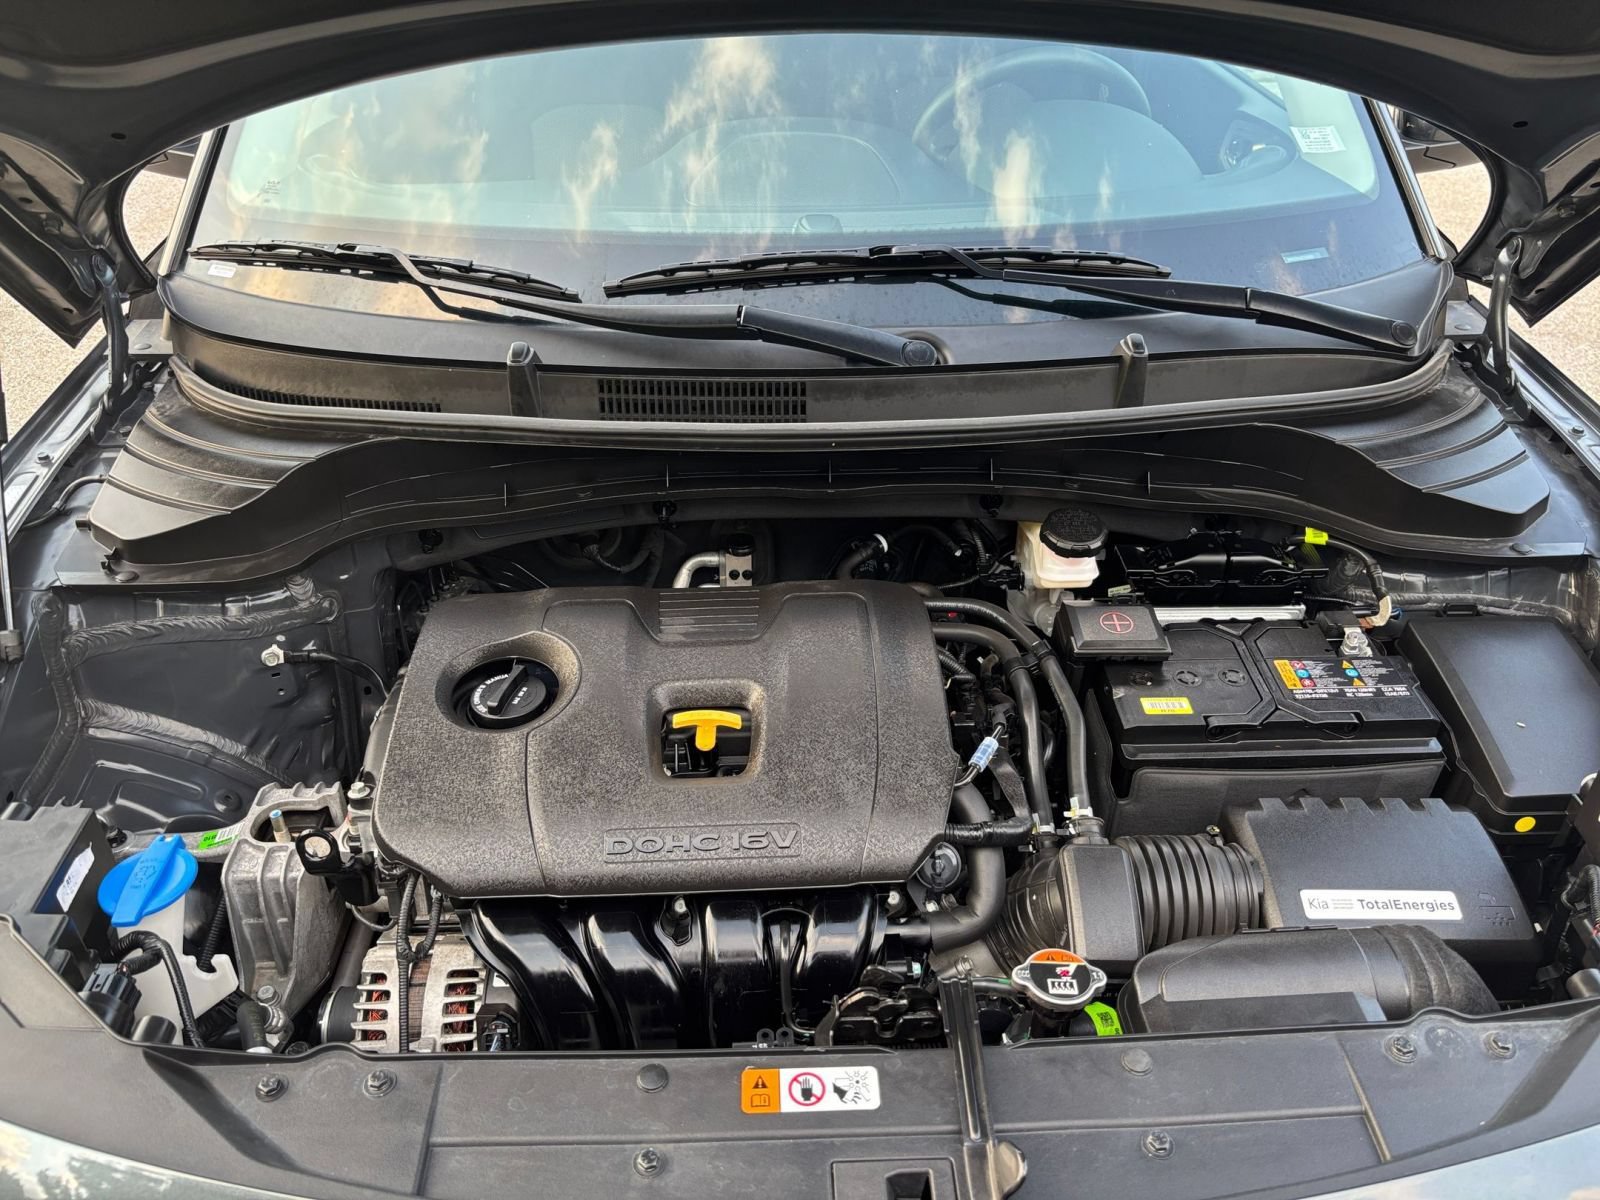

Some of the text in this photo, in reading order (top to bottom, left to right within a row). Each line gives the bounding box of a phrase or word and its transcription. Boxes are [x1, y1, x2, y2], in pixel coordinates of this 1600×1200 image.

[485, 673, 511, 685] MANUA
[606, 829, 798, 856] DOHC 16V
[1308, 897, 1330, 910] Kia
[1356, 898, 1456, 913] TotalEnergies
